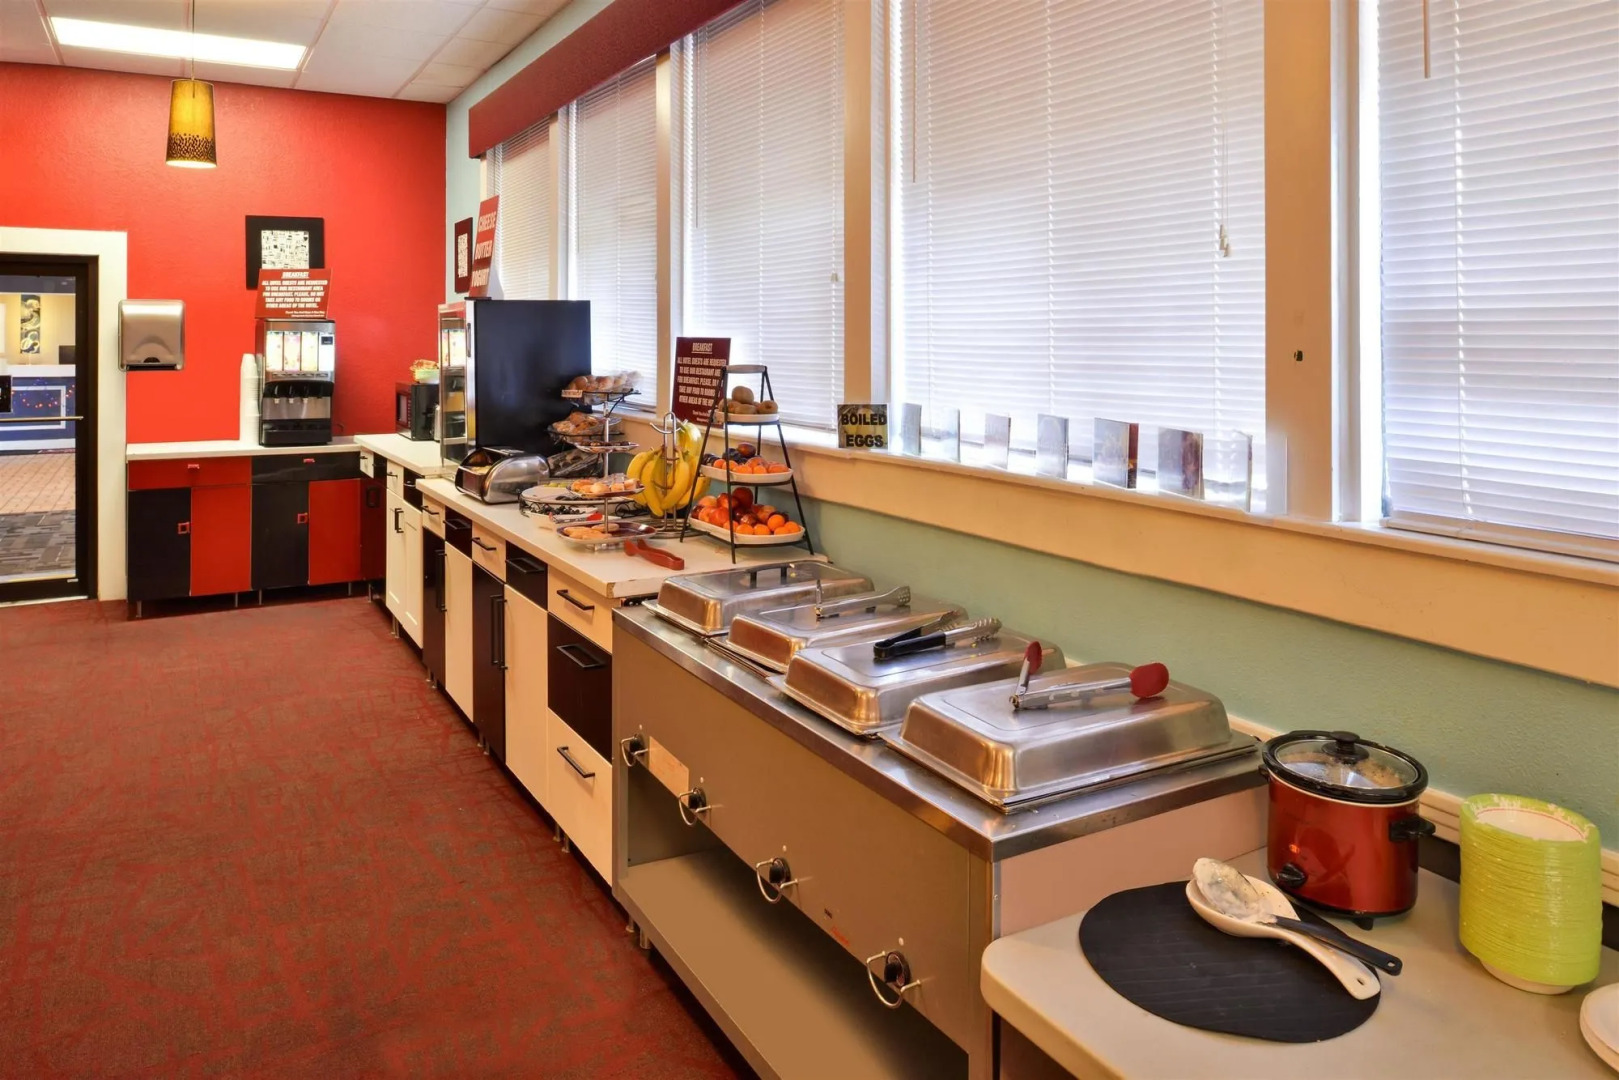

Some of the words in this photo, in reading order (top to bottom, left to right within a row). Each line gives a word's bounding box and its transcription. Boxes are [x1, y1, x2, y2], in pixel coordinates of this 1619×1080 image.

[478, 212, 496, 232] CHEESE
[475, 240, 492, 260] BUTTER
[471, 268, 489, 287] YOGURT
[692, 343, 712, 352] BREAKFAST
[696, 368, 714, 376] RESTAURANT
[841, 414, 887, 425] BOILED
[846, 435, 883, 447] EGGS
